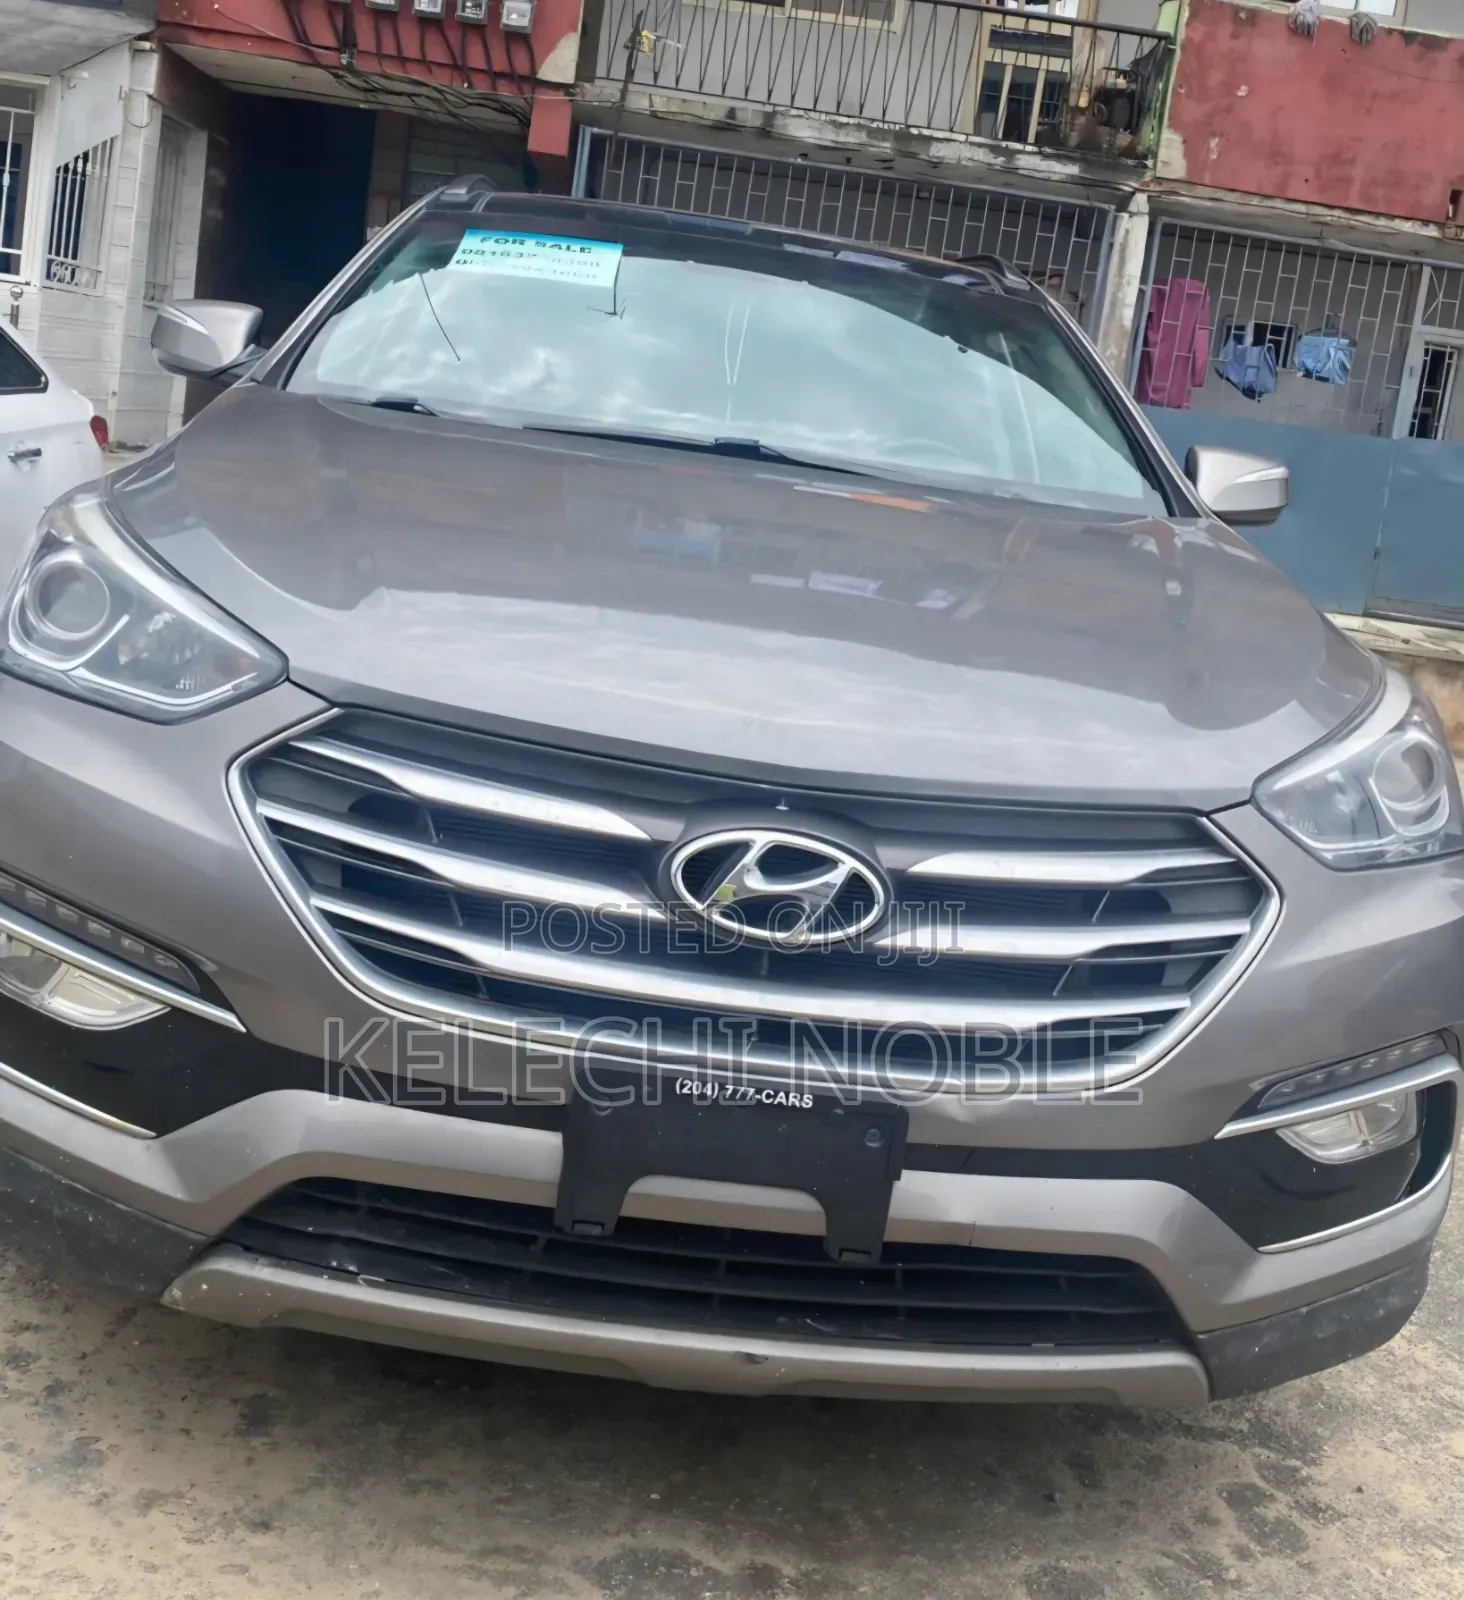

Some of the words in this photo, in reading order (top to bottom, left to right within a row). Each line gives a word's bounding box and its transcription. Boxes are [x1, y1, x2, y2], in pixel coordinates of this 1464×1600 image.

[480, 235, 527, 246] FOR
[675, 1076, 719, 1099] (204)
[725, 1084, 814, 1109] 777-CARS
